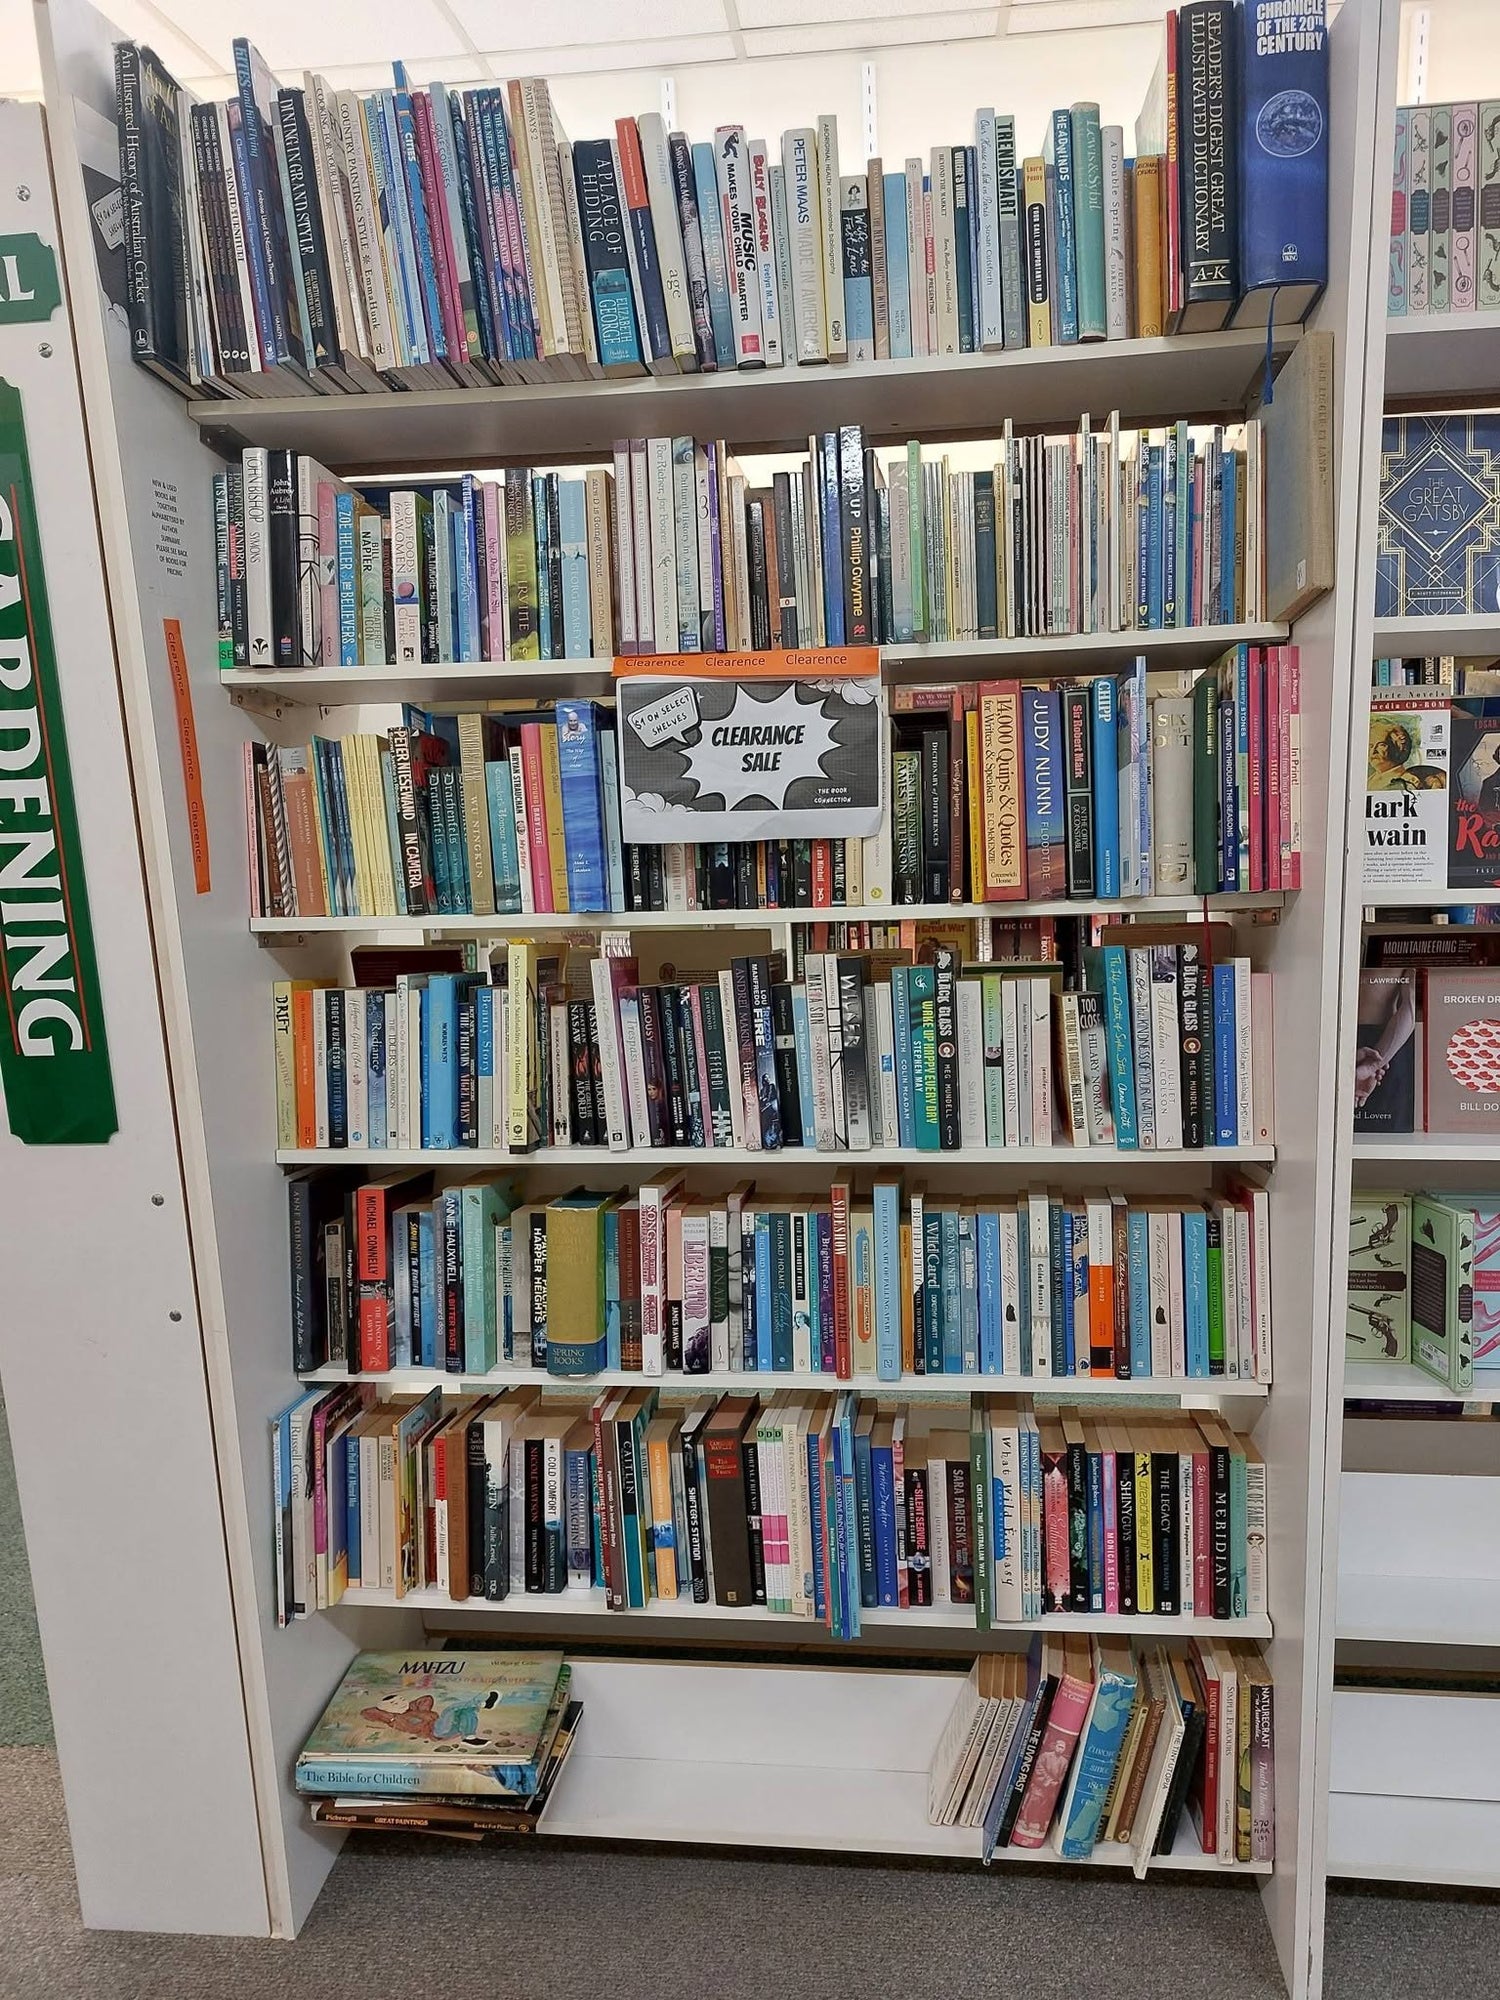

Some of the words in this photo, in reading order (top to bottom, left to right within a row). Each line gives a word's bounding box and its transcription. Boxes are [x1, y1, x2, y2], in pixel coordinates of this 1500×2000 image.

[1256, 0, 1323, 20] CHRONICLE
[1257, 21, 1272, 37] OF
[1275, 20, 1296, 34] THE
[1298, 16, 1323, 31] 20TH
[120, 50, 133, 68] An
[1208, 11, 1223, 99] READER'S
[1257, 33, 1323, 56] CENTURY
[1191, 13, 1208, 137] ILLUSTRATED
[124, 73, 138, 131] Illustrated
[280, 100, 300, 146] DINING
[1209, 102, 1224, 167] DIGEST
[125, 135, 141, 179] History
[404, 132, 417, 162] CITIES
[597, 159, 612, 169] A
[794, 138, 806, 182] PETER
[1055, 115, 1069, 181] HEADWINDS
[289, 164, 308, 212] GRAND
[728, 163, 738, 200] MAKES
[754, 155, 764, 191] BULLY
[997, 123, 1016, 217] TRENDSMART
[130, 182, 144, 196] of
[599, 172, 618, 227] PLACE
[797, 185, 809, 223] MAAS
[1193, 142, 1210, 254] DICTIONARY
[1211, 169, 1225, 232] GREAT
[582, 174, 603, 242] HIDING
[731, 203, 741, 232] YOUR
[131, 199, 146, 258] Australian
[297, 213, 315, 255] STYLE
[606, 233, 623, 255] OF
[741, 212, 756, 271] MUSIC
[733, 237, 743, 267] CHILD
[135, 261, 149, 303] Cricket
[1194, 266, 1226, 281] A-K
[737, 272, 748, 321] SMARTER
[599, 299, 619, 345] GEORGE
[616, 298, 631, 343] ELIZABETH
[246, 456, 264, 483] JOHN
[1428, 478, 1444, 487] THE
[248, 486, 265, 522] BISHOP
[1403, 504, 1469, 521] GATSBY
[1409, 487, 1463, 505] GREAT
[249, 532, 261, 563] SYMONS
[340, 532, 352, 569] HELLER
[850, 527, 862, 565] Phillip
[852, 567, 863, 616] Gwynne
[341, 592, 355, 644] BELIEVERS
[167, 632, 185, 696] Clearence
[625, 659, 685, 668] Clearence
[705, 657, 765, 667] Clearence
[786, 654, 847, 665] Clearence
[635, 717, 647, 730] $1
[647, 710, 661, 722] ON
[661, 694, 690, 715] SELECT
[1098, 680, 1112, 723] CHIPP
[652, 713, 688, 736] SHELVES
[712, 725, 805, 747] CLEARANCE
[996, 698, 1013, 744] 14,000
[1033, 700, 1050, 751] JUDY
[1225, 718, 1233, 750] QUILTING
[183, 718, 195, 780] Clearence
[394, 729, 407, 761] PETER
[741, 752, 782, 773] SALE
[897, 760, 908, 799] JAMES
[998, 748, 1015, 792] Quips
[1035, 757, 1051, 815] NUNN
[1225, 752, 1233, 789] THROUGH
[396, 761, 415, 820] NIESEWAND
[1000, 795, 1015, 811] &
[1456, 800, 1476, 813] the
[191, 801, 203, 863] Clearence
[404, 832, 418, 845] IN
[897, 803, 909, 874] PATTERSON
[1226, 804, 1234, 837] SEASONS
[1365, 823, 1427, 846] wain
[999, 814, 1014, 866] Quotes
[405, 846, 422, 888] CAMERA
[1383, 940, 1456, 954] MOUNTAINEERING
[937, 973, 951, 1003] BLACK
[276, 995, 289, 1034] DRIFT
[480, 995, 491, 1034] Beauty
[921, 1001, 934, 1028] WAKE
[939, 1007, 952, 1036] GLASS
[371, 1022, 381, 1070] Radiance
[923, 1030, 934, 1042] UP
[1088, 1033, 1099, 1073] HILARY
[480, 1041, 492, 1072] Story
[912, 1040, 922, 1074] STEPHEN
[923, 1043, 936, 1073] HAPPY
[914, 1076, 923, 1092] MAY
[924, 1075, 936, 1105] EVERY
[945, 1084, 953, 1119] MUNDELL
[1091, 1075, 1103, 1126] NORMAN
[926, 1106, 937, 1124] DAY
[1364, 1111, 1392, 1119] Lovers
[1460, 1102, 1481, 1111] BILL
[365, 1196, 378, 1231] MICHAEL
[833, 1199, 847, 1257] SIDESHOW
[367, 1235, 379, 1275] CONNELLY
[533, 1227, 542, 1272] HARPER
[925, 1221, 940, 1254] Wild
[683, 1240, 707, 1321] LIBERATOR
[713, 1256, 725, 1321] PANAMA
[927, 1254, 940, 1289] Card
[534, 1277, 542, 1323] HEIGHTS
[290, 1426, 302, 1460] Russell
[291, 1464, 302, 1498] Crowe
[547, 1456, 556, 1477] COLD
[953, 1469, 964, 1494] SARA
[1160, 1469, 1170, 1490] THE
[547, 1480, 557, 1516] COMFORT
[861, 1499, 870, 1513] THE
[1160, 1493, 1171, 1533] LEGACY
[861, 1514, 871, 1541] SILENT
[954, 1497, 966, 1545] PARETSKY
[1107, 1532, 1115, 1564] MONICA
[1215, 1492, 1227, 1587] MERIDIAN
[863, 1544, 872, 1572] SENTRY
[1107, 1567, 1115, 1591] SELES
[1260, 1687, 1271, 1749] NATURECRAFT
[1021, 1744, 1037, 1772] LIVING
[305, 1771, 325, 1783] The
[327, 1772, 354, 1783] Bible
[356, 1773, 371, 1784] for
[373, 1773, 421, 1785] Children
[1014, 1771, 1030, 1793] PAST
